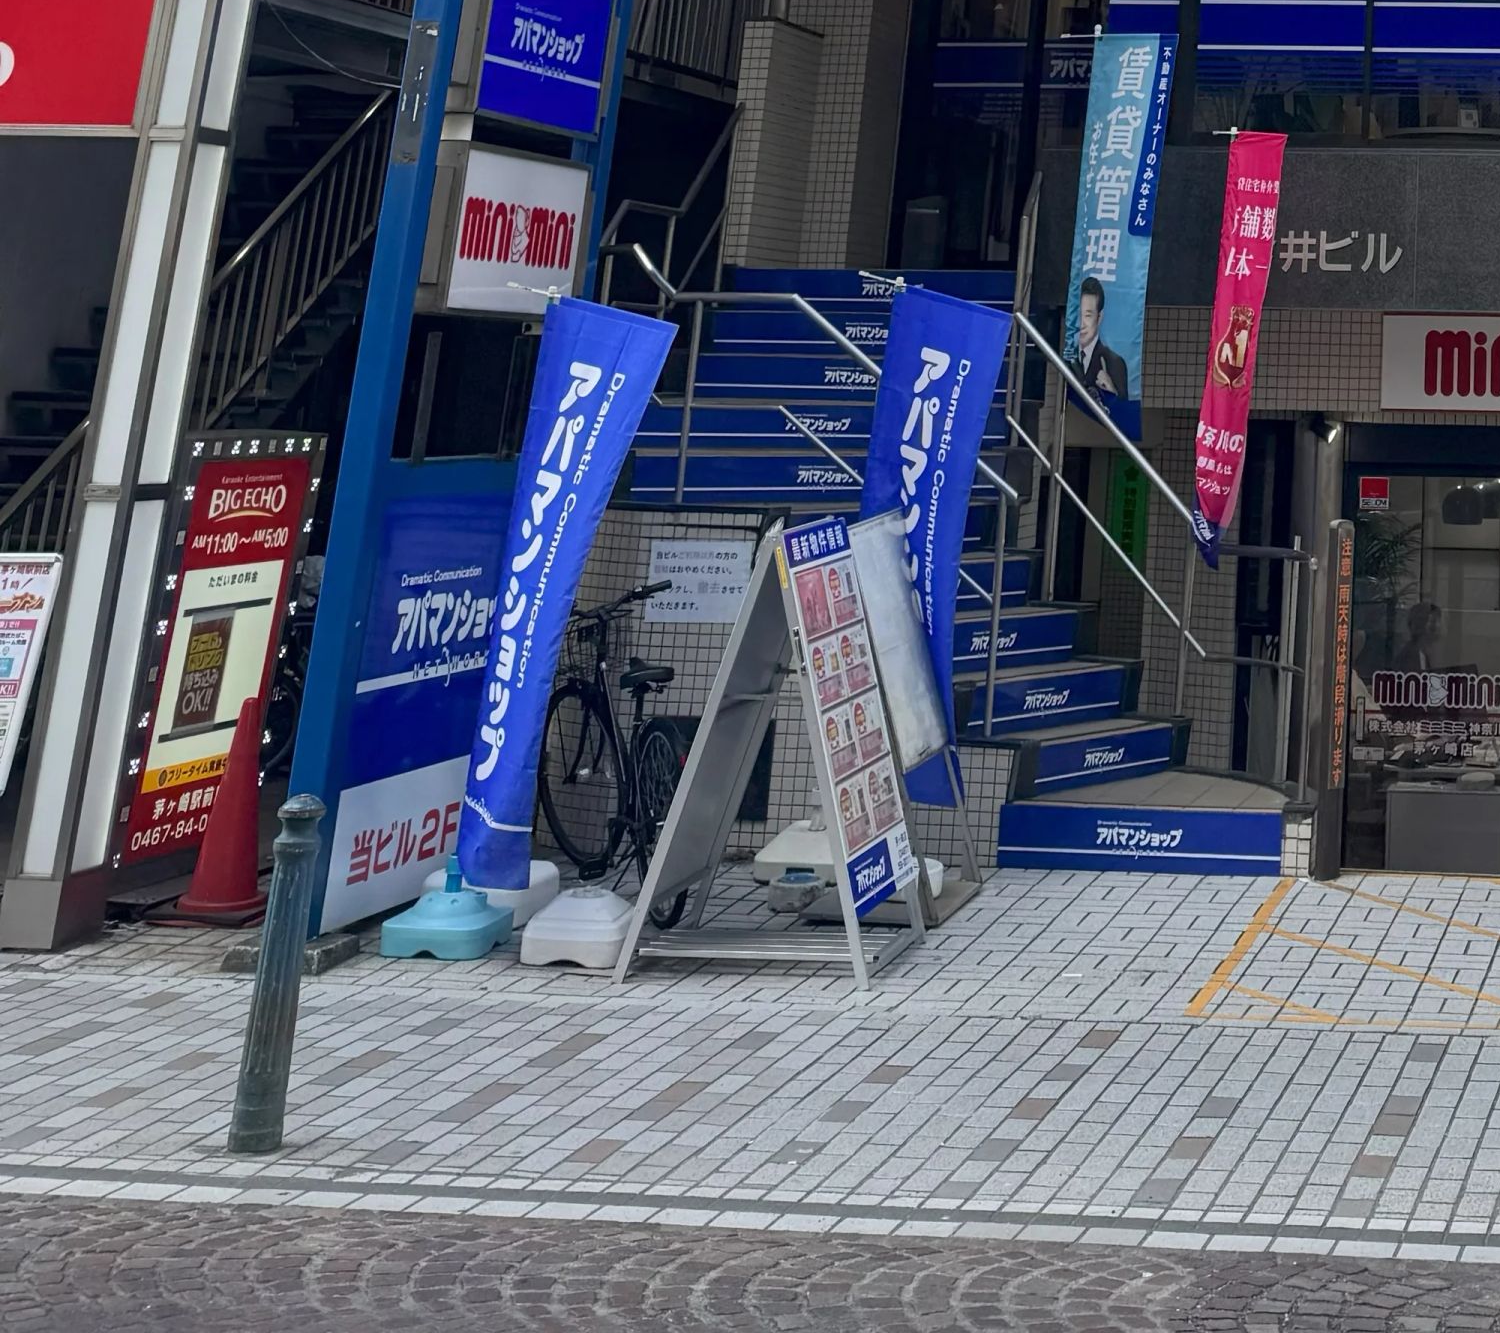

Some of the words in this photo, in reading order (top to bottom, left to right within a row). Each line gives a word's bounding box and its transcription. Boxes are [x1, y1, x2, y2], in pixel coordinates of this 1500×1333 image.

[511, 16, 585, 65] アパマンショップ
[1083, 45, 1154, 283] 賃貸管理
[1134, 46, 1173, 227] 不動産オーナーのみなさん
[459, 196, 515, 264] mini
[525, 206, 576, 271] mini
[1279, 229, 1403, 275] 井ビル
[572, 372, 626, 485] Dramatic
[936, 359, 972, 465] Dramatic
[208, 488, 243, 520] BIG
[243, 484, 287, 513] ECHO
[401, 571, 433, 587] Dramatic
[434, 565, 484, 583] Communication
[476, 361, 603, 781] アパマンショップ
[518, 493, 578, 689] Communication
[1096, 827, 1183, 848] アパマンショップ
